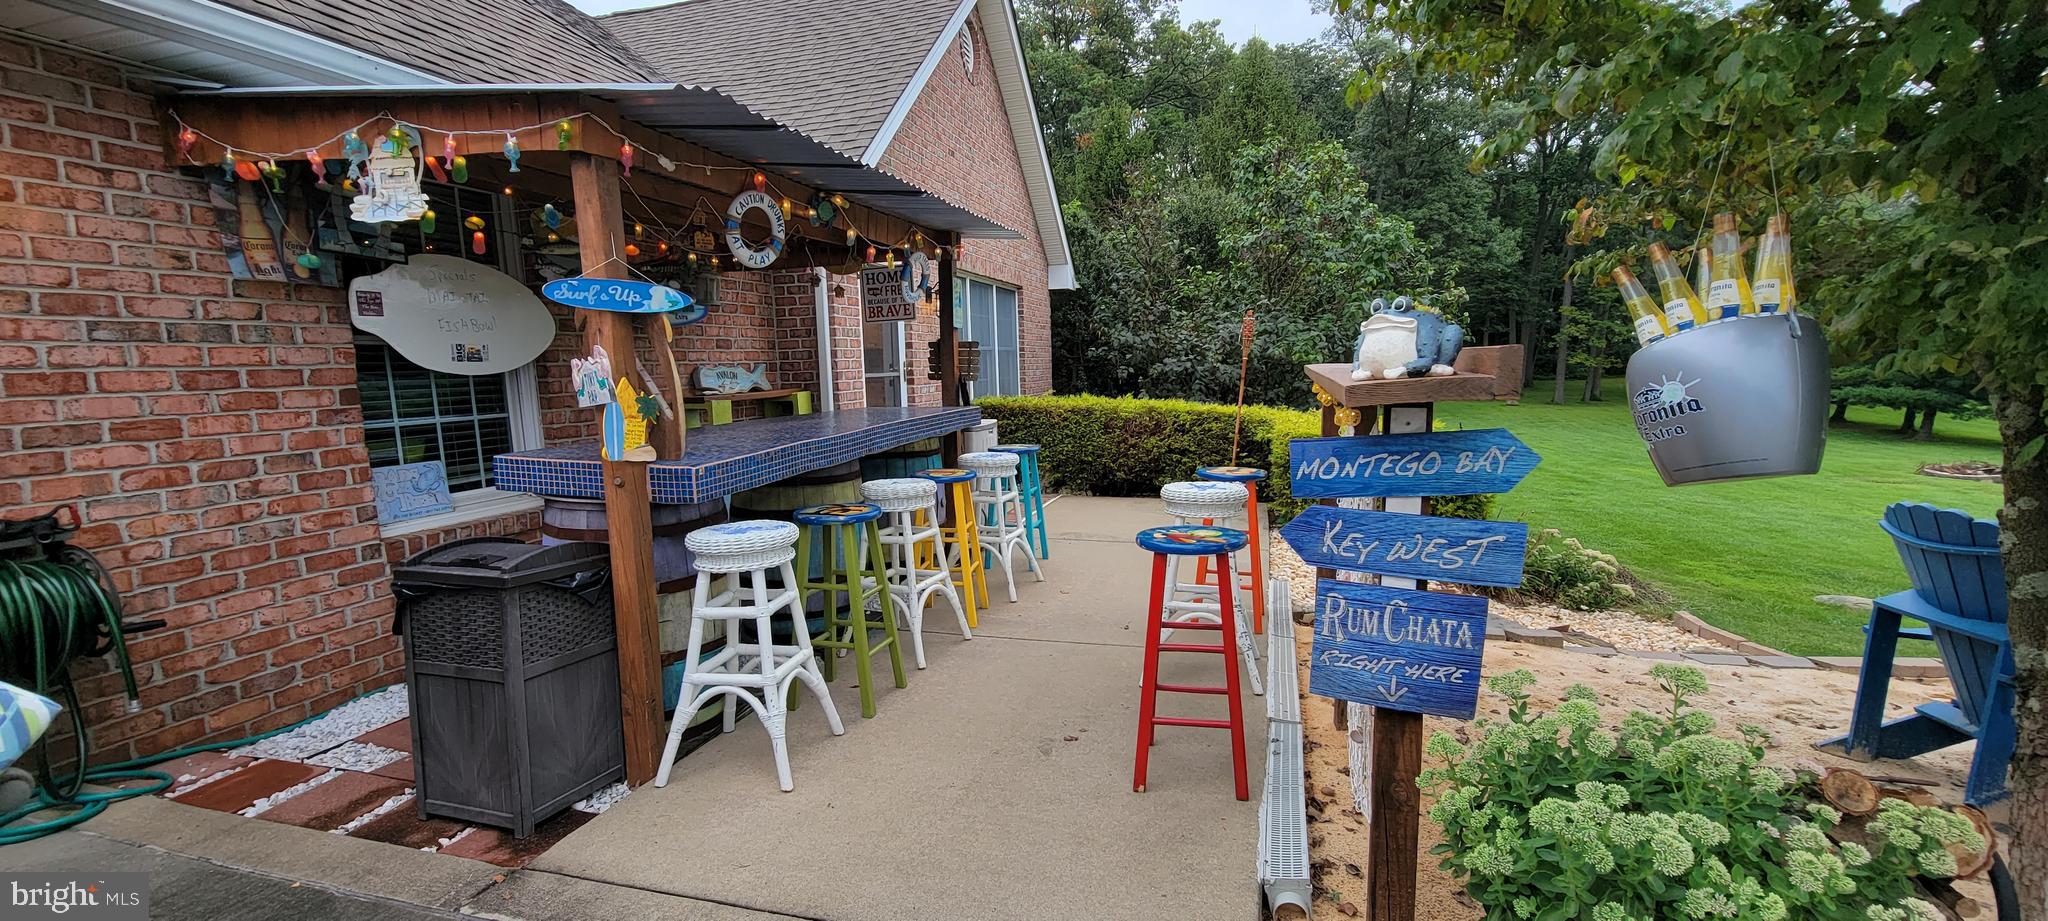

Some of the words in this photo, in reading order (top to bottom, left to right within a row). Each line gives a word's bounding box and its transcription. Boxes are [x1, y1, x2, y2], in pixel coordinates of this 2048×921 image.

[735, 193, 765, 216] CAUTION
[767, 200, 785, 234] DRUNKS
[732, 236, 745, 250] AT
[748, 253, 771, 265] PLAY
[864, 270, 901, 285] HOM
[608, 285, 642, 307] Up
[885, 285, 902, 296] FRE
[867, 297, 890, 305] BECAUSE
[867, 303, 912, 319] BRAVE
[455, 343, 463, 362] BIG
[715, 371, 738, 381] AVALON
[1296, 451, 1442, 480] MONTEGO
[1455, 446, 1516, 474] BAY
[1322, 519, 1380, 565] KEY
[1386, 533, 1507, 569] WEST
[1319, 650, 1406, 674] RIGHT
[1405, 663, 1470, 684] HERE
